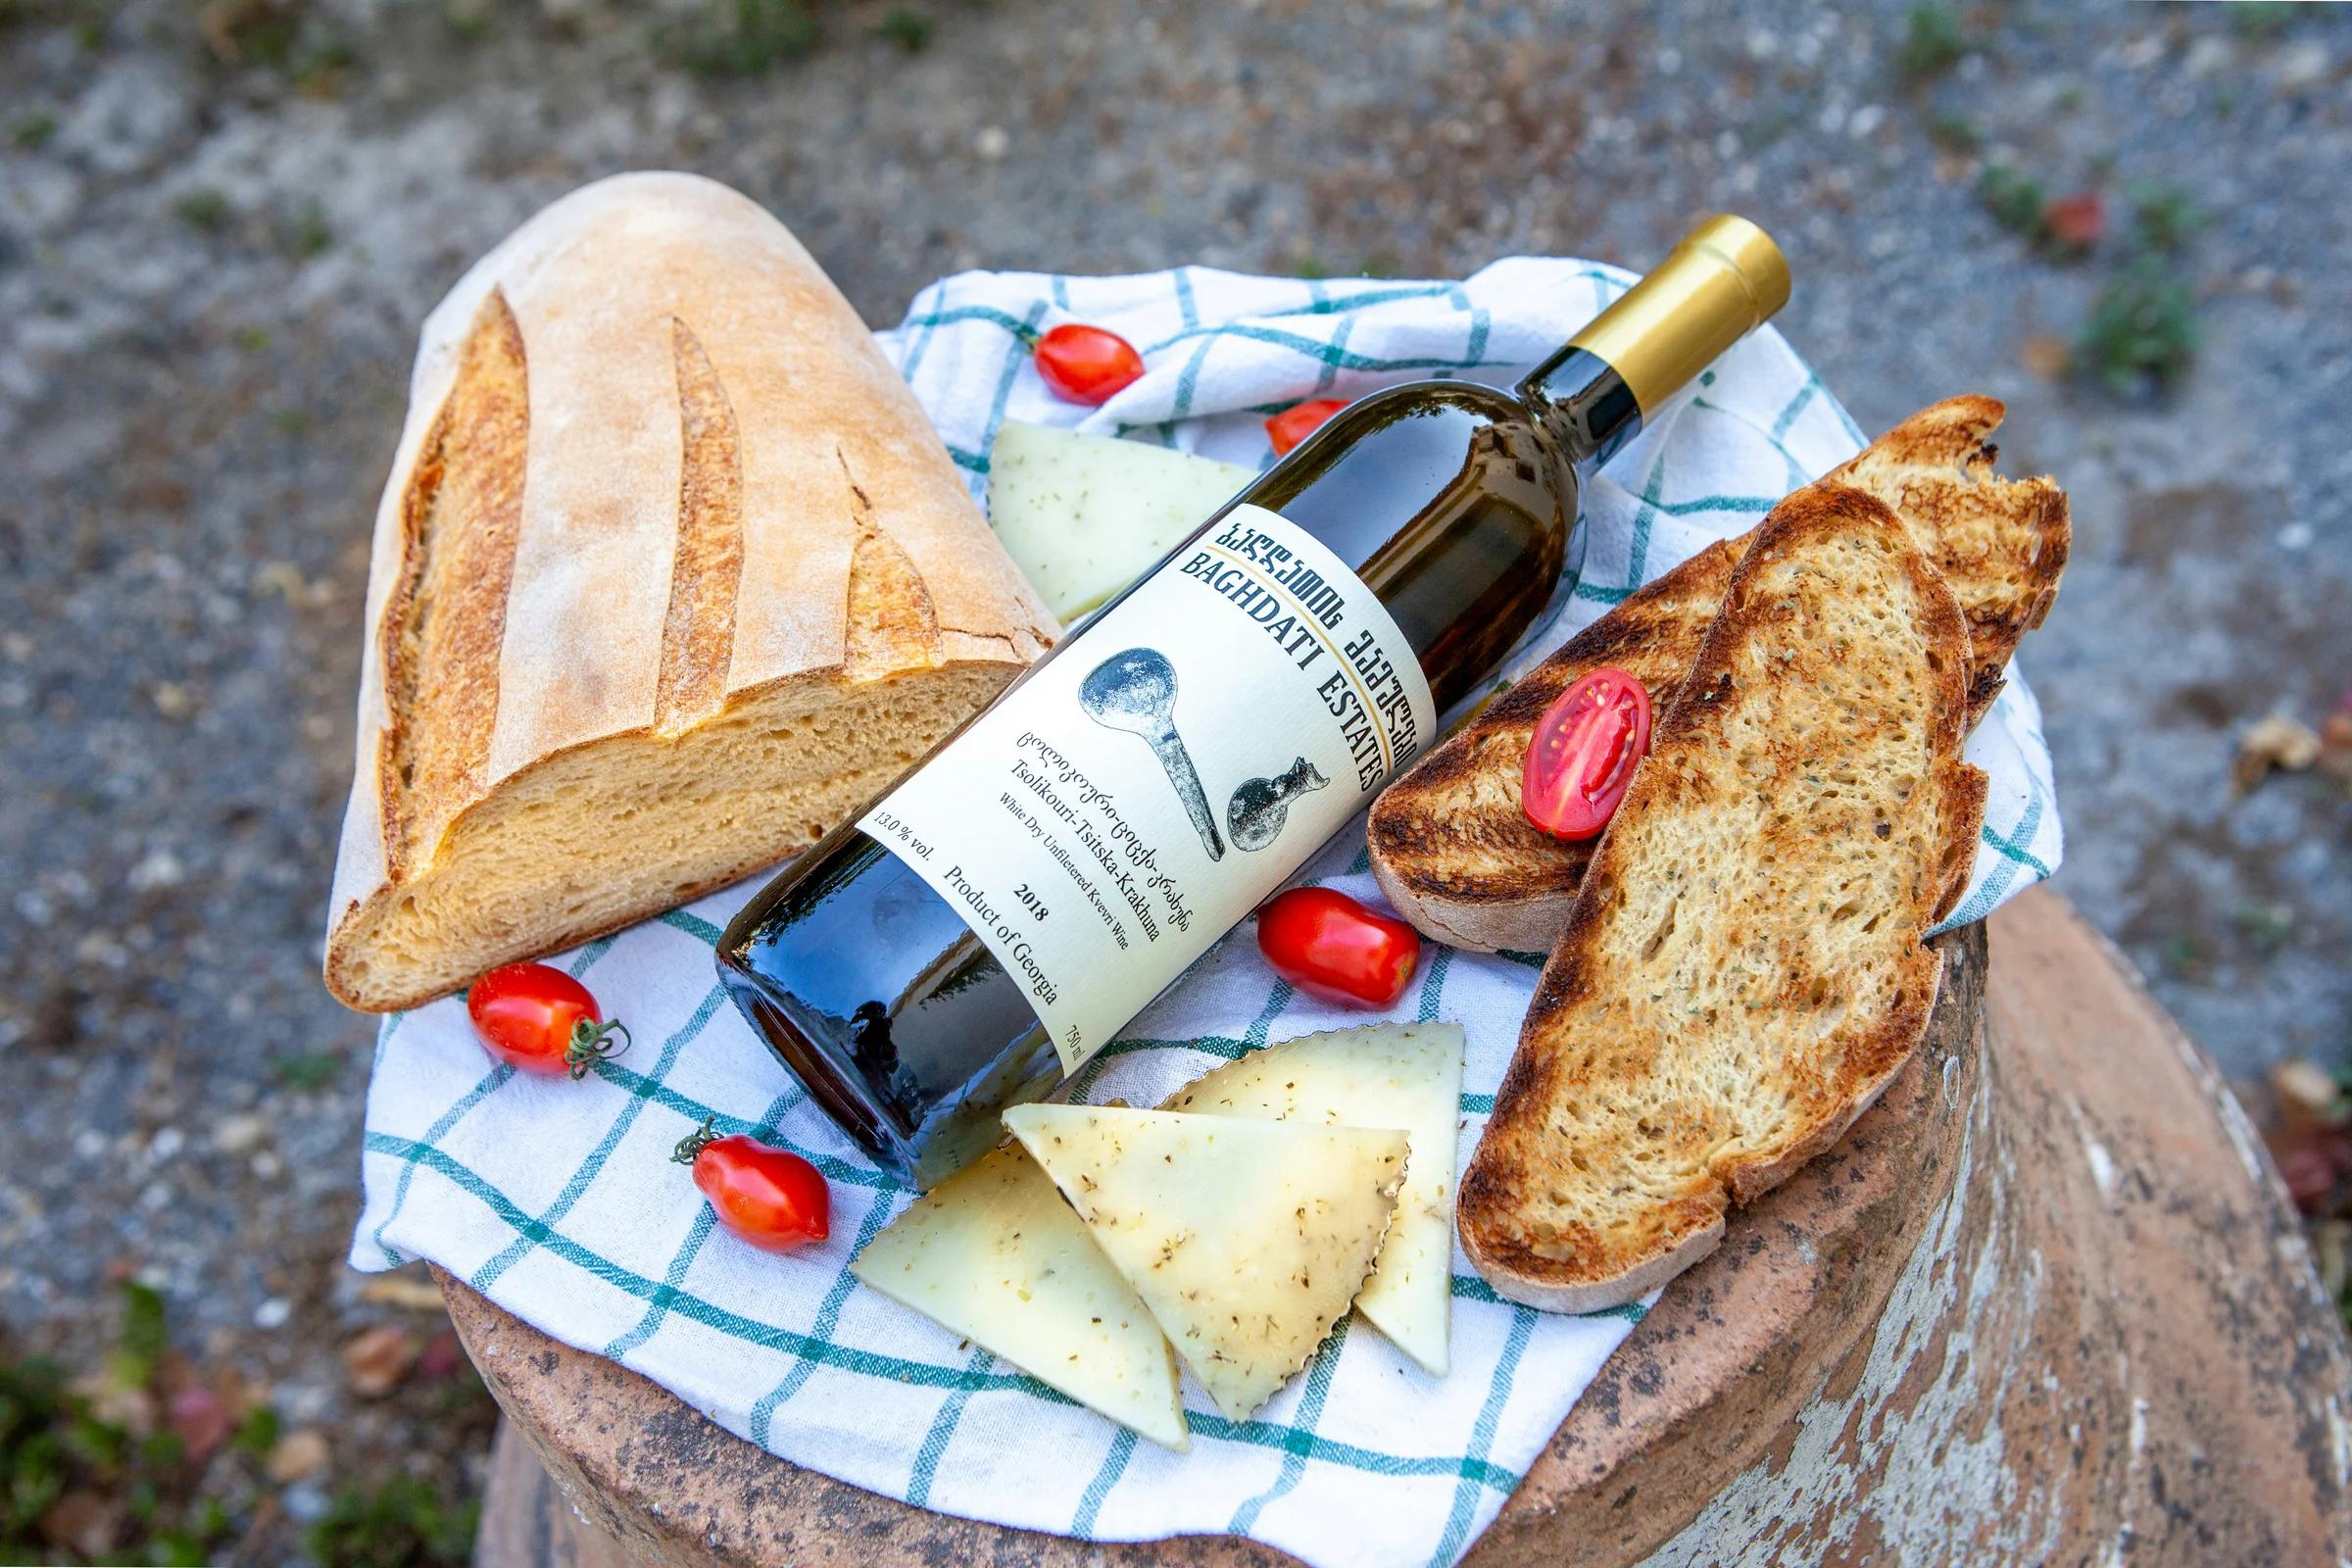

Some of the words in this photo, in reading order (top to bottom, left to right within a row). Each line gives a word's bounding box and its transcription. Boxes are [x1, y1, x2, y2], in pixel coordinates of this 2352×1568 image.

[1215, 522, 1346, 630] ბაღდათის
[1180, 552, 1325, 671] BAGHDATI
[1316, 670, 1383, 792] ESTATES
[873, 811, 901, 831] 13.0
[896, 825, 909, 842] %
[910, 839, 936, 861] vol.
[1000, 792, 1027, 820] White
[1024, 816, 1045, 839] Dry
[1043, 835, 1094, 893] Unfiletered
[1087, 888, 1117, 926] Kvevri
[1111, 921, 1129, 951] Wine
[1010, 759, 1160, 943] Tsolikouri-Tsitska-Krakhuna
[943, 865, 1001, 927] Product
[996, 924, 1021, 947] of
[1012, 942, 1057, 1006] Georgia
[1013, 883, 1049, 922] 2018
[1064, 1024, 1083, 1050] 750
